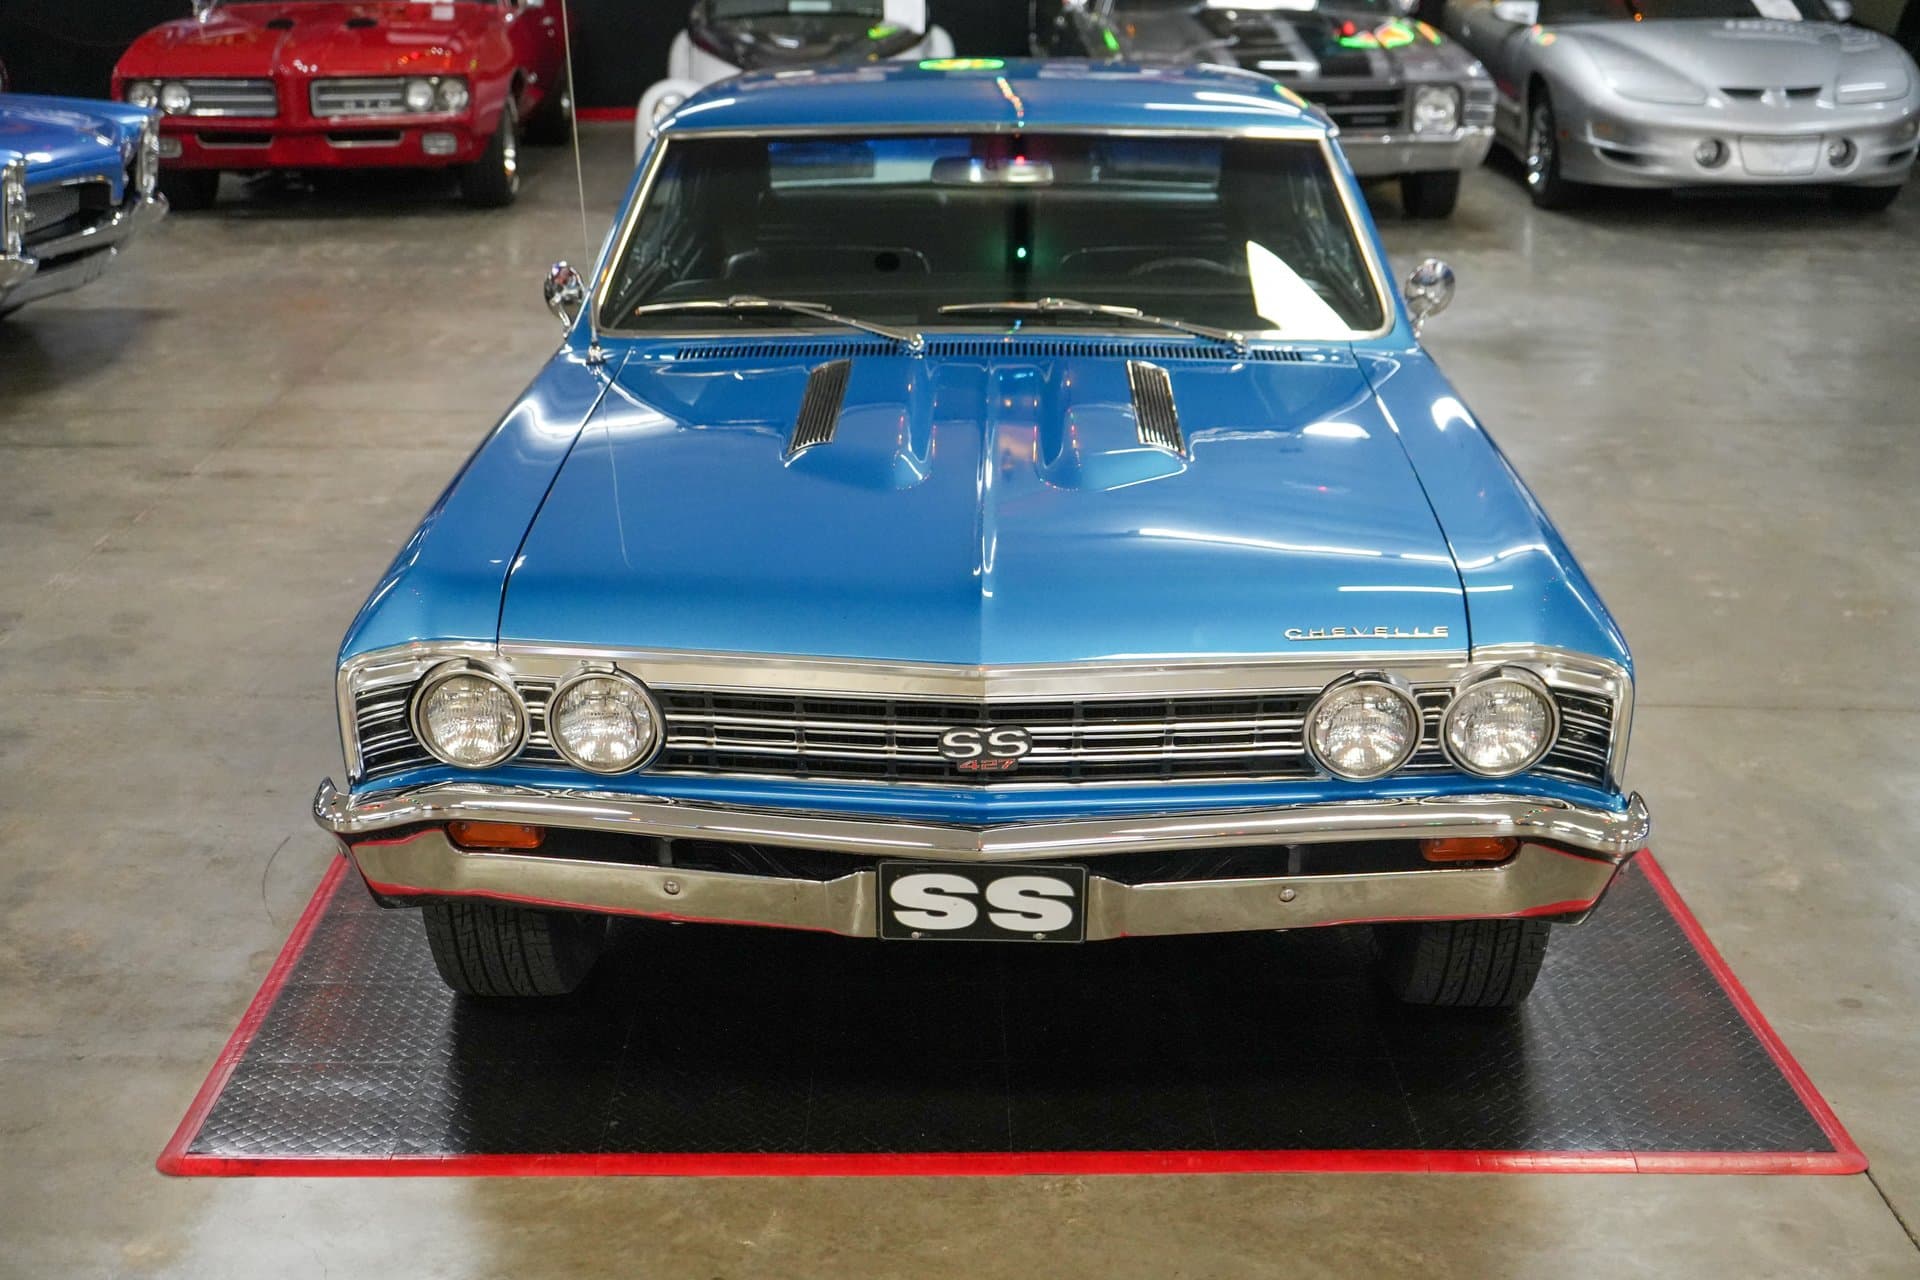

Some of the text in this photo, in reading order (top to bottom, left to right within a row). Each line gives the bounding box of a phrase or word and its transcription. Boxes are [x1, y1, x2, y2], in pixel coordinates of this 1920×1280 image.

[1284, 626, 1449, 640] CHEVELLE
[942, 731, 1029, 758] SS
[959, 759, 1015, 770] 427
[890, 873, 1075, 932] SS
